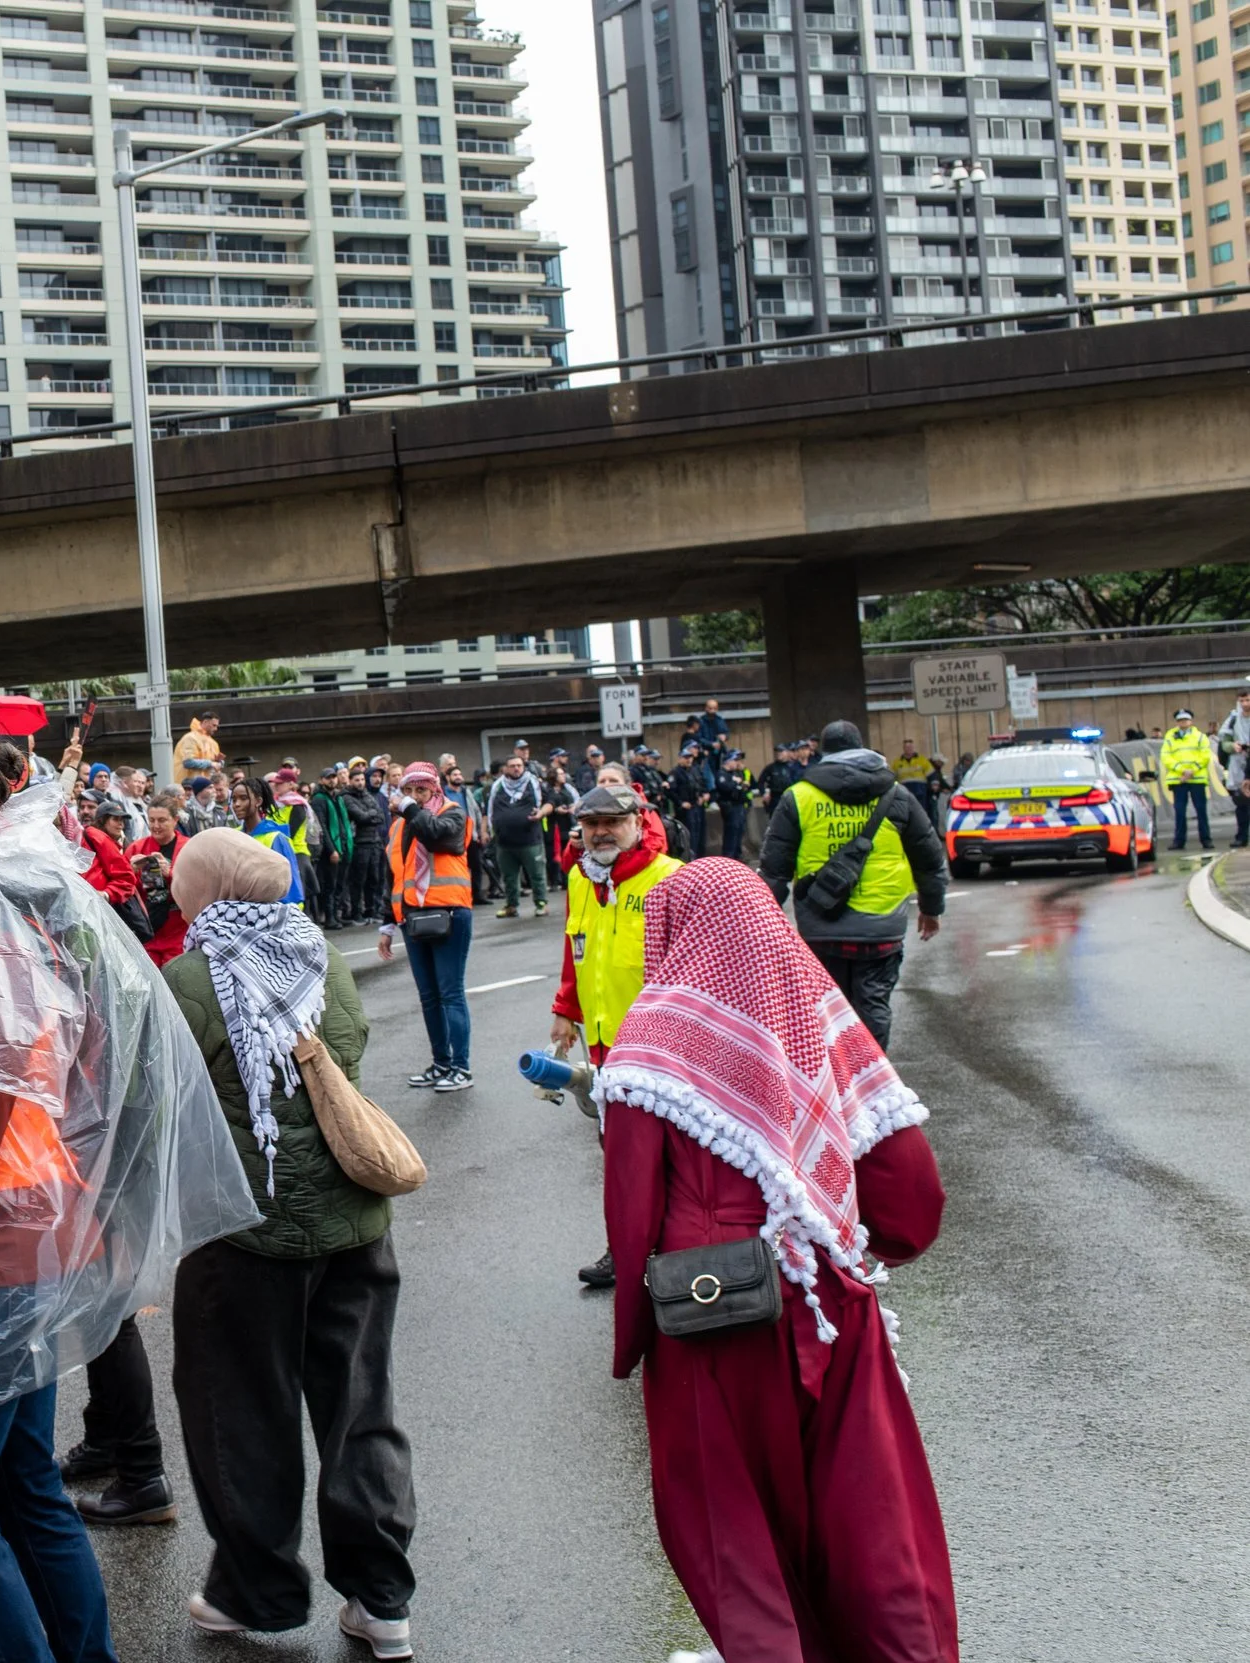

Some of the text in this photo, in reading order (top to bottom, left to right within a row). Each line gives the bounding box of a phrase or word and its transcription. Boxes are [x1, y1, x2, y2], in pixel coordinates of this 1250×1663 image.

[939, 660, 978, 672] START
[928, 671, 991, 685] VARIABLE
[605, 689, 635, 700] FORM
[922, 683, 999, 698] SPEED LIMIT
[945, 697, 979, 709] ZONE
[618, 703, 625, 719] 1
[607, 721, 637, 733] LANE
